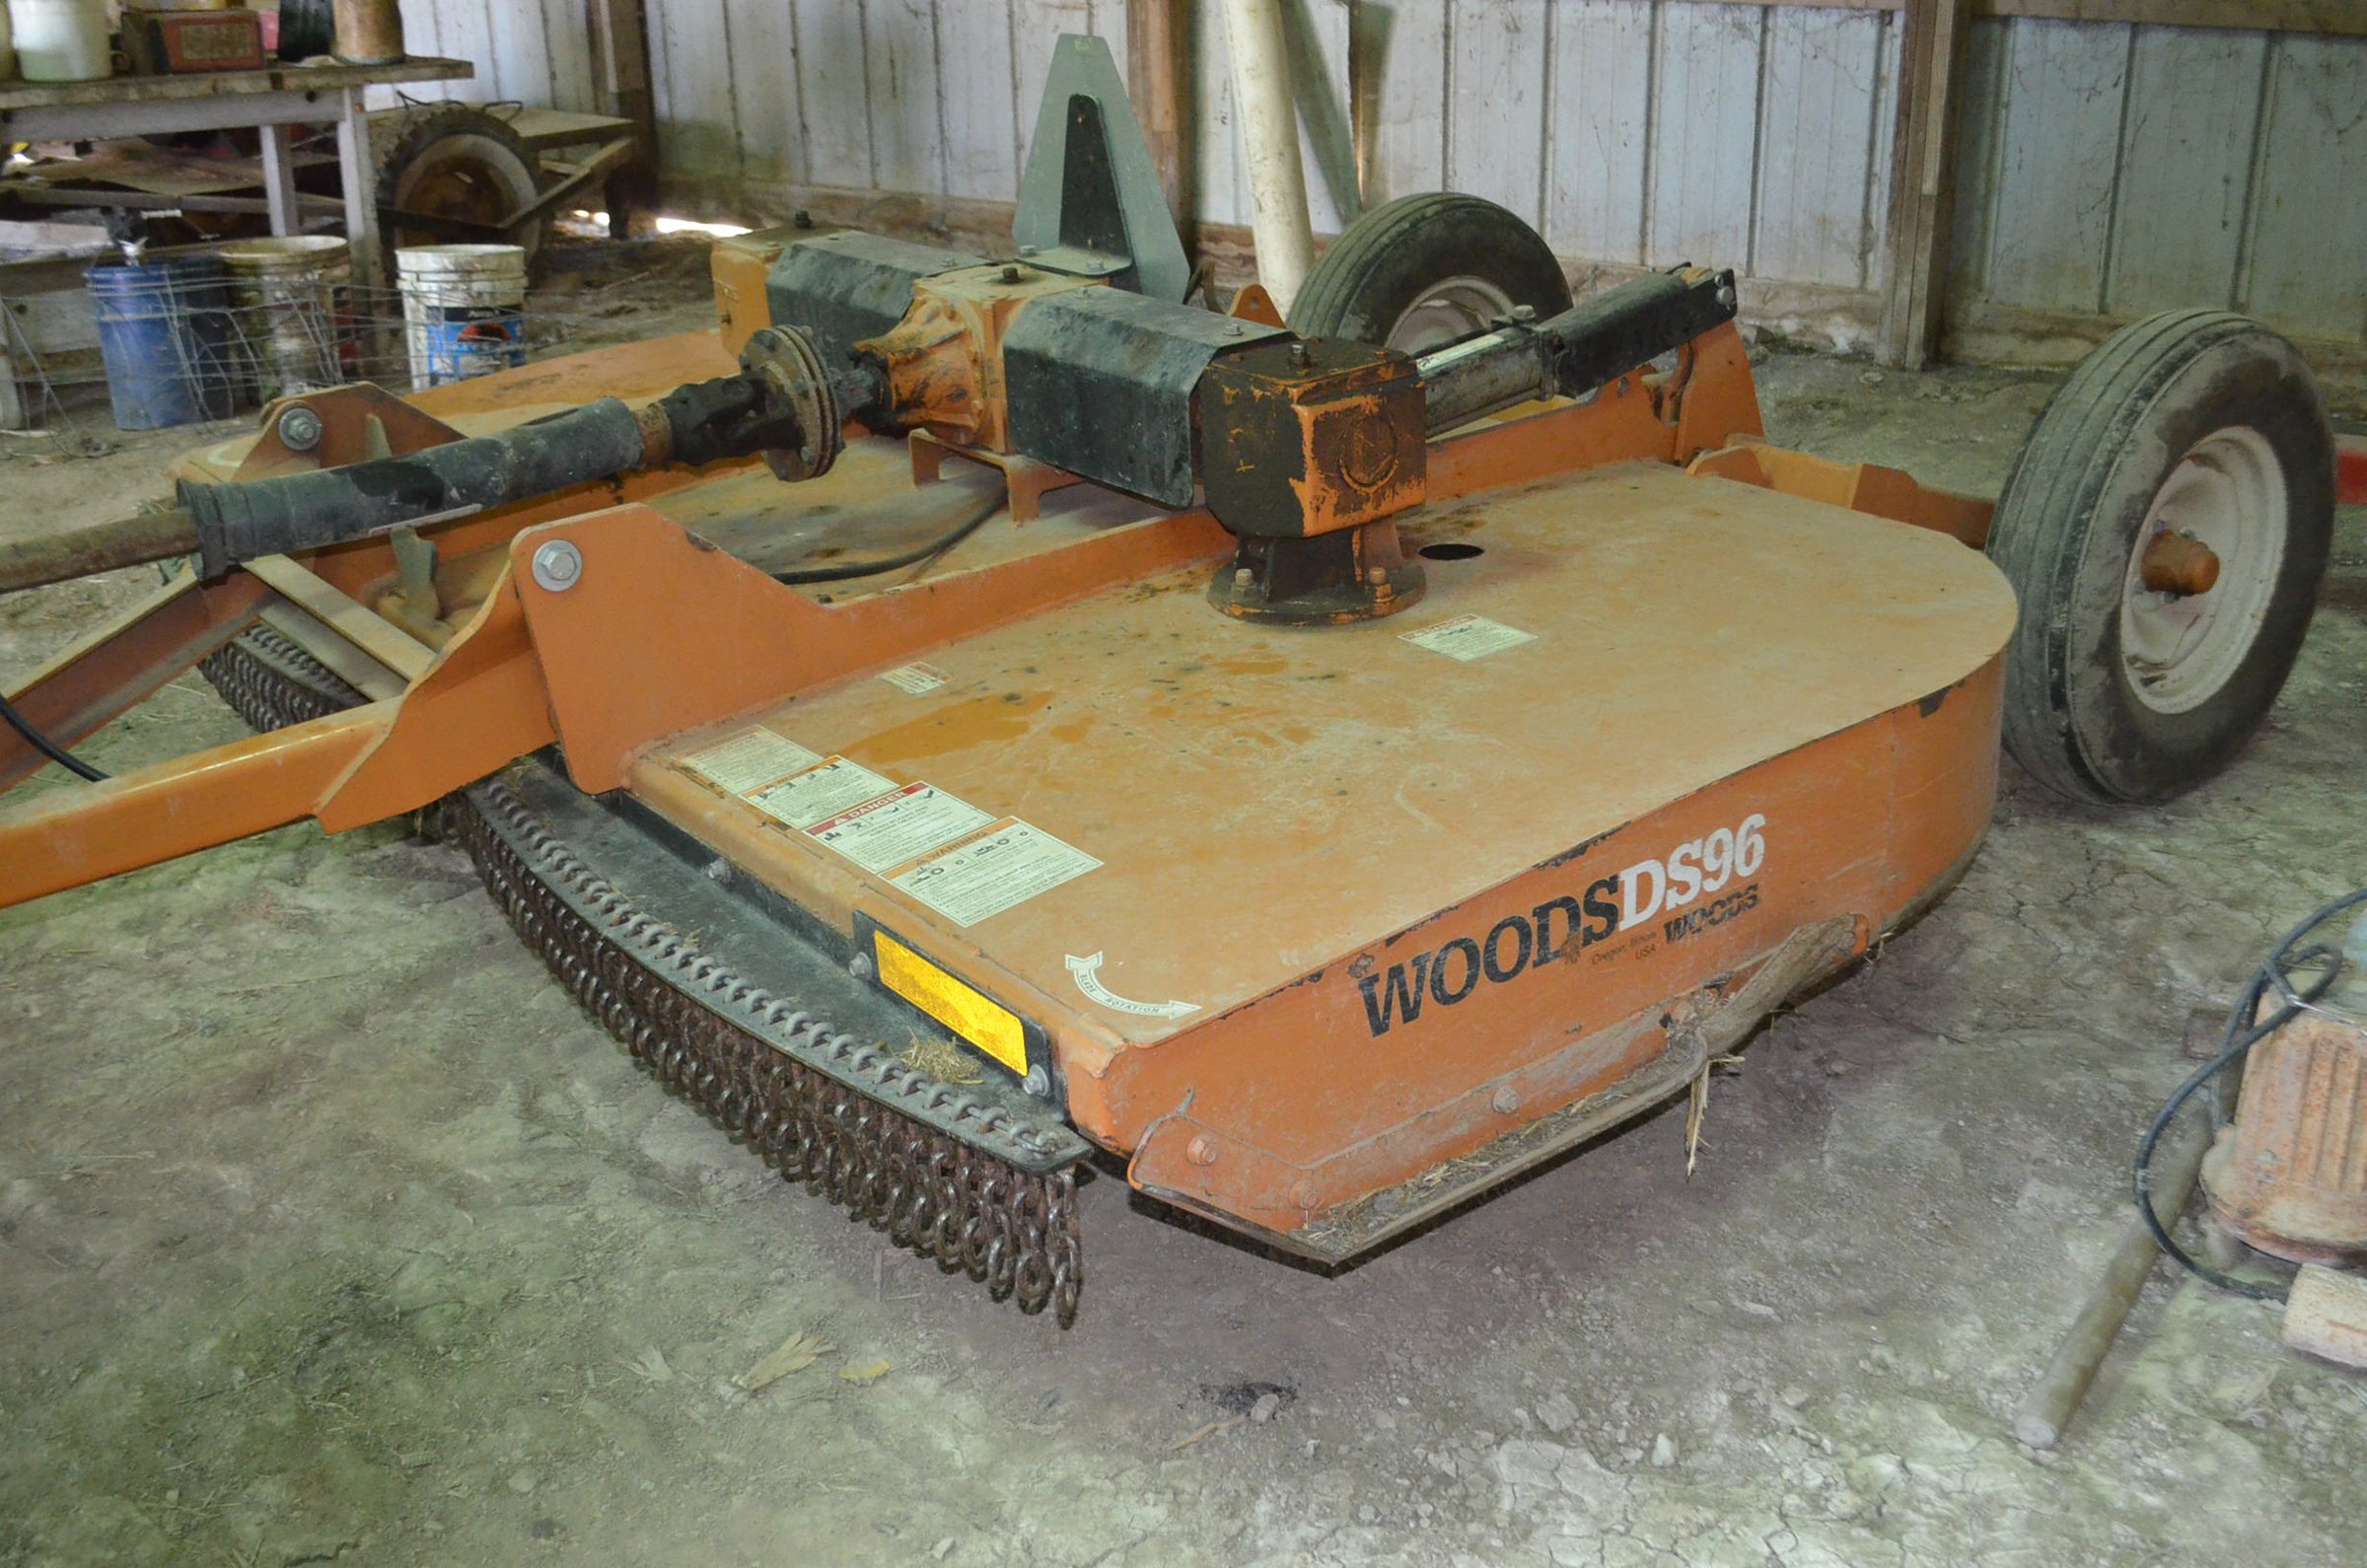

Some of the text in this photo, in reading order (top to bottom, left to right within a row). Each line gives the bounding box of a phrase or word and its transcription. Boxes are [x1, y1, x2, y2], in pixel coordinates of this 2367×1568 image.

[849, 791, 906, 818] DANGER
[1357, 814, 1765, 1038] WOODS DS96
[1106, 998, 1160, 1013] ROTATION
